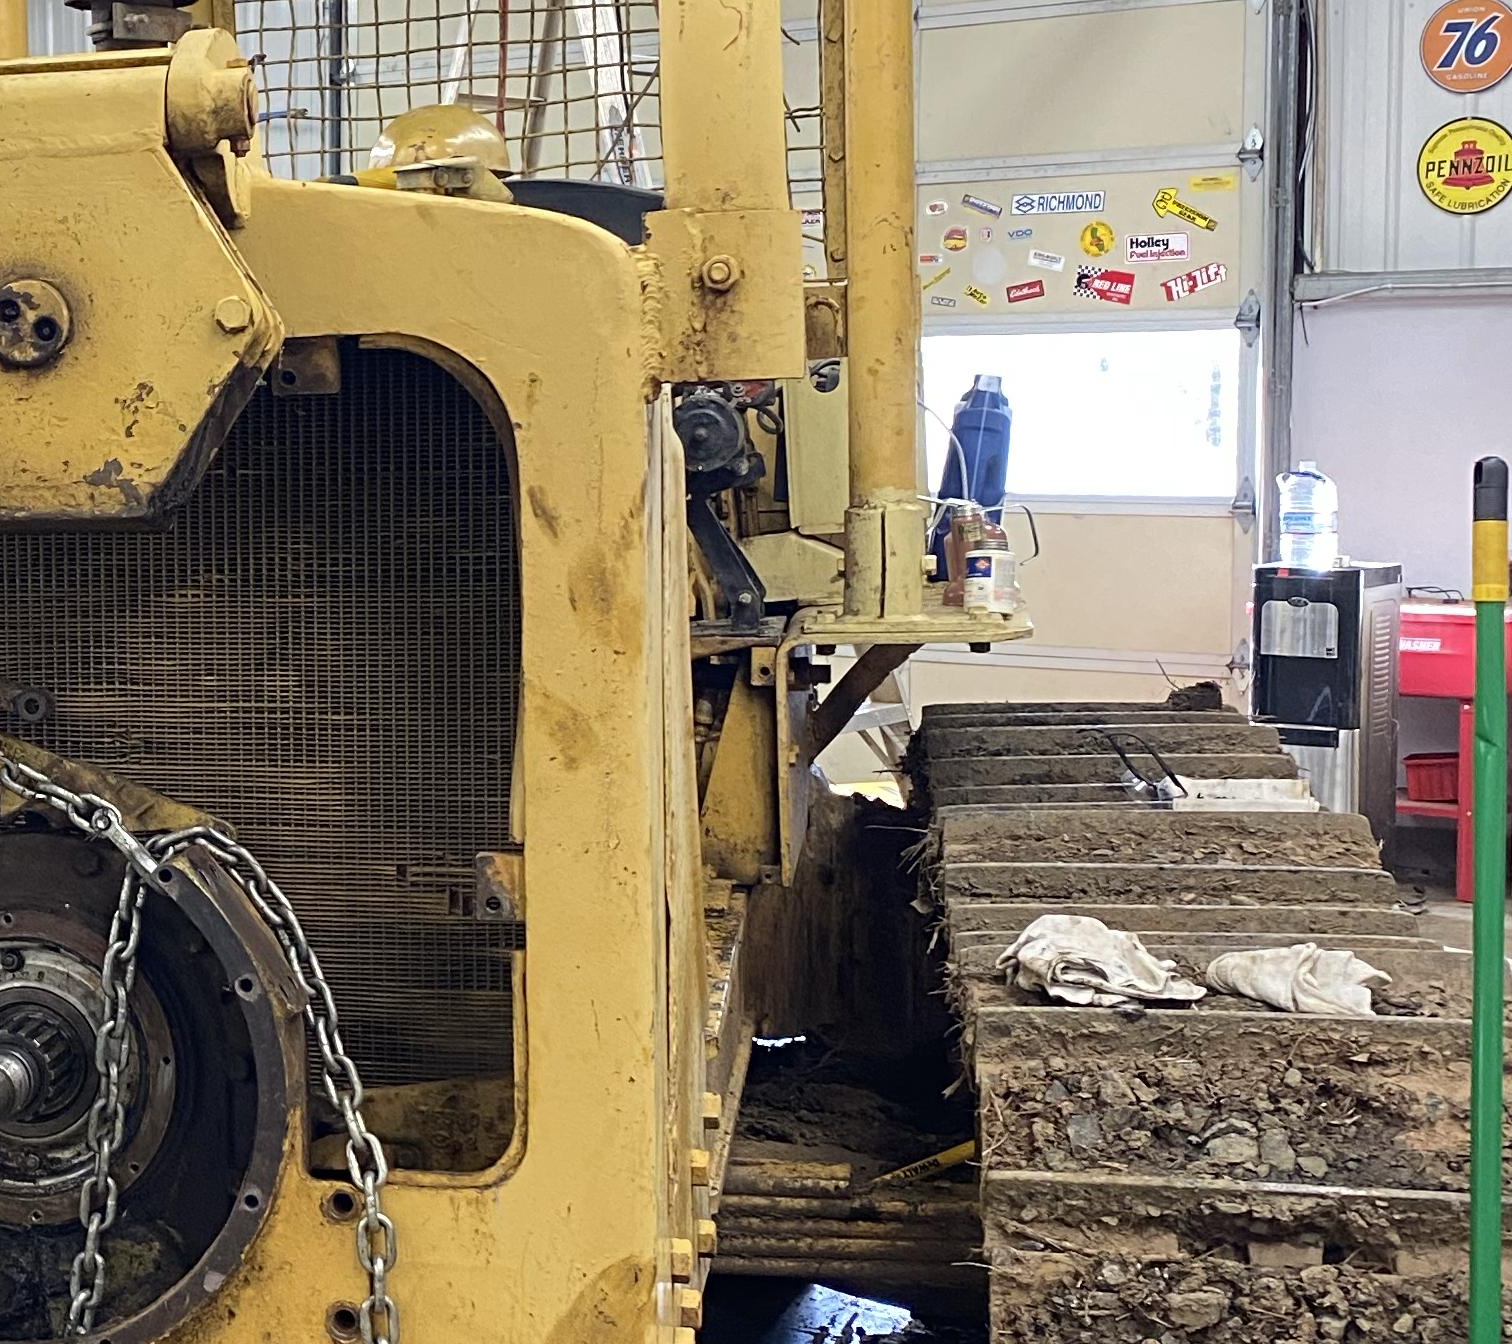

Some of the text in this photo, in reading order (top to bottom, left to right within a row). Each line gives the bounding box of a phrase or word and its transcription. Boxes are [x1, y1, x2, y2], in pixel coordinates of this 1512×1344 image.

[1432, 12, 1504, 71] 76
[1446, 72, 1488, 80] GASOLINE
[1425, 154, 1512, 179] PENNZOIL
[1426, 178, 1510, 210] SAFE LUBRICATION
[1038, 194, 1101, 211] RICHMOND
[1008, 229, 1033, 237] VDO
[1129, 237, 1170, 250] Holley
[1130, 249, 1186, 261] Fuel Injection
